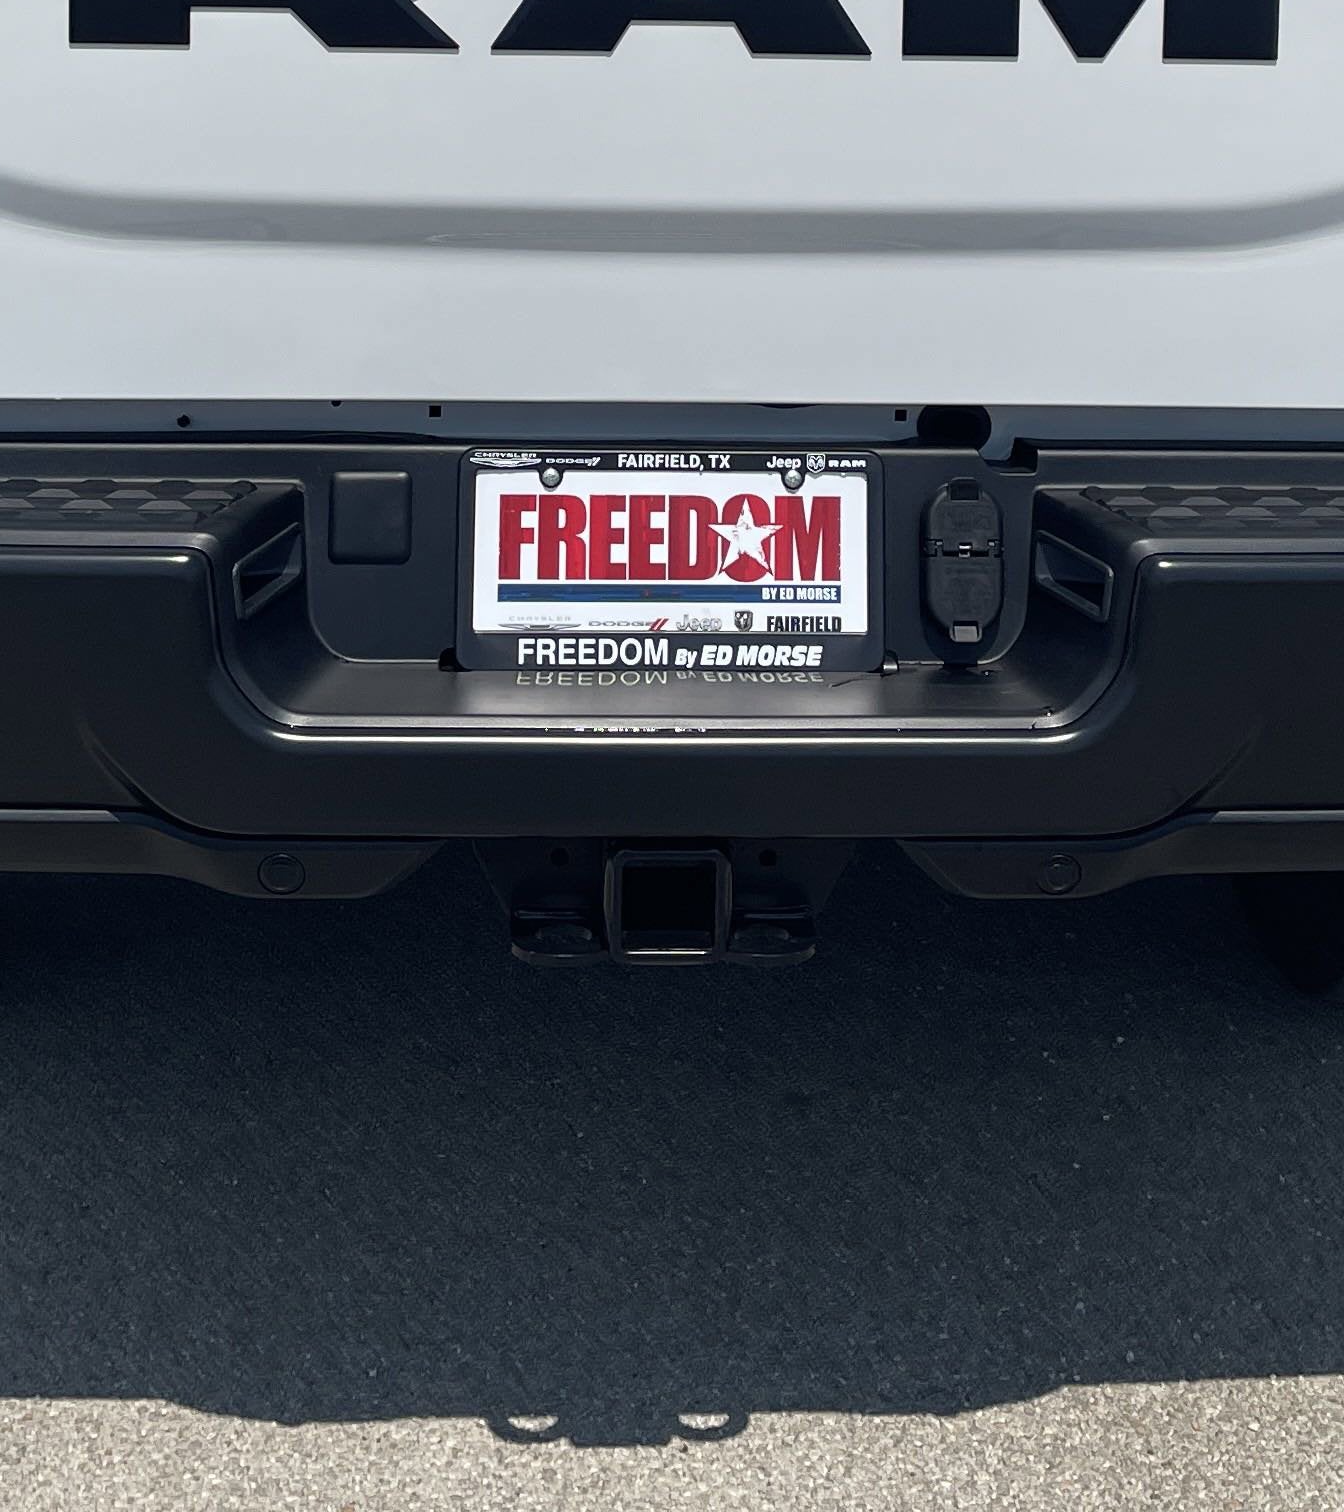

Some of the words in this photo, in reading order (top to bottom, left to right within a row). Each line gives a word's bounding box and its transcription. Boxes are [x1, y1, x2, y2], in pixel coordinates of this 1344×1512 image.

[617, 454, 704, 470] FAIRFIELD,
[708, 454, 731, 468] TX
[766, 455, 802, 470] Jeep
[828, 459, 867, 468] RAM
[498, 493, 841, 583] FREEDOM
[762, 587, 778, 600] BY
[781, 587, 795, 600] ED
[796, 587, 838, 600] MORSE
[675, 614, 723, 632] Jeep
[766, 615, 843, 633] FAIRFIELD
[517, 637, 670, 666] FREEDOM
[674, 648, 698, 669] By
[700, 644, 734, 666] ED
[735, 644, 824, 667] MORSE
